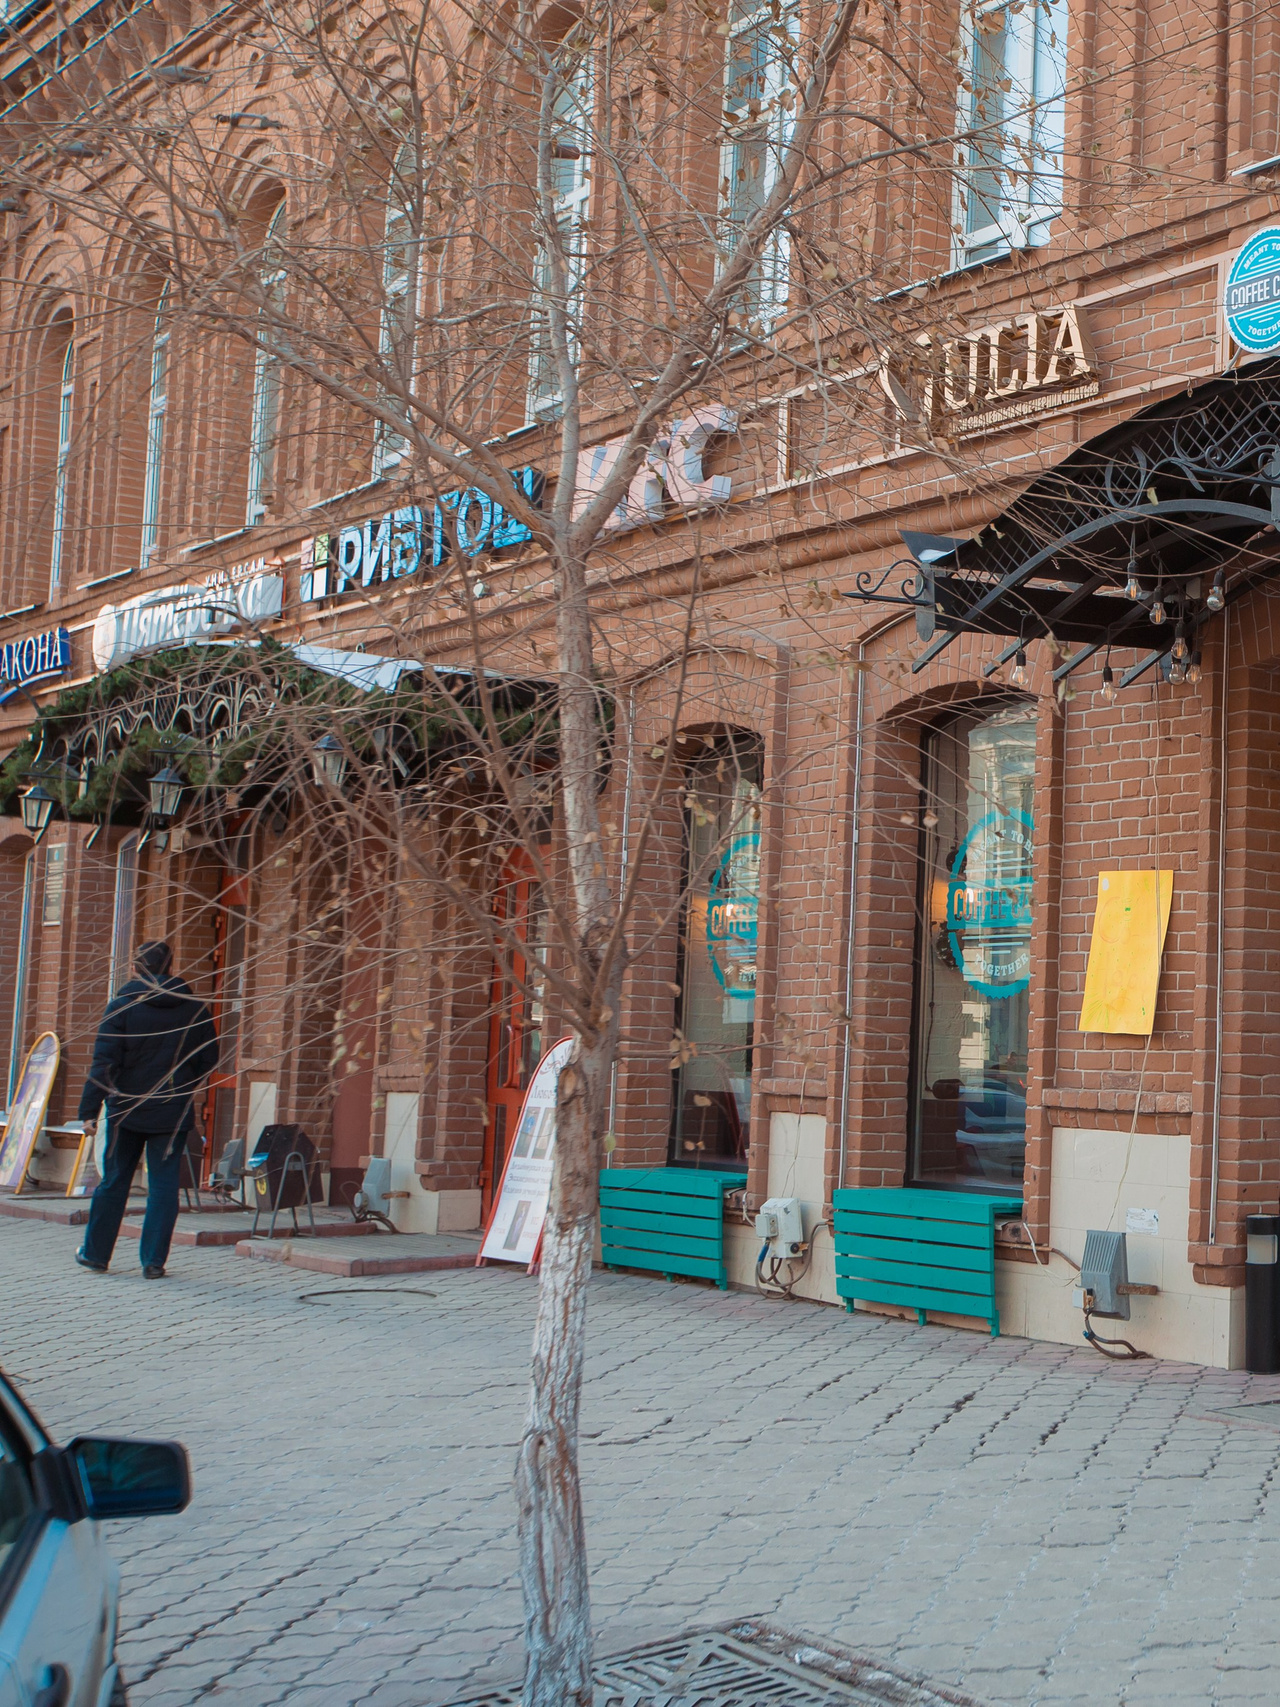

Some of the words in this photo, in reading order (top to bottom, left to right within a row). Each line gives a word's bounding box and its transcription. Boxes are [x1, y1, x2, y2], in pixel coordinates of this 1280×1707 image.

[1243, 244, 1269, 270] MEANT
[1271, 242, 1280, 251] TO
[1231, 278, 1270, 310] COFFEE
[1011, 830, 1024, 845] TO
[974, 952, 1030, 977] TOGETHER
